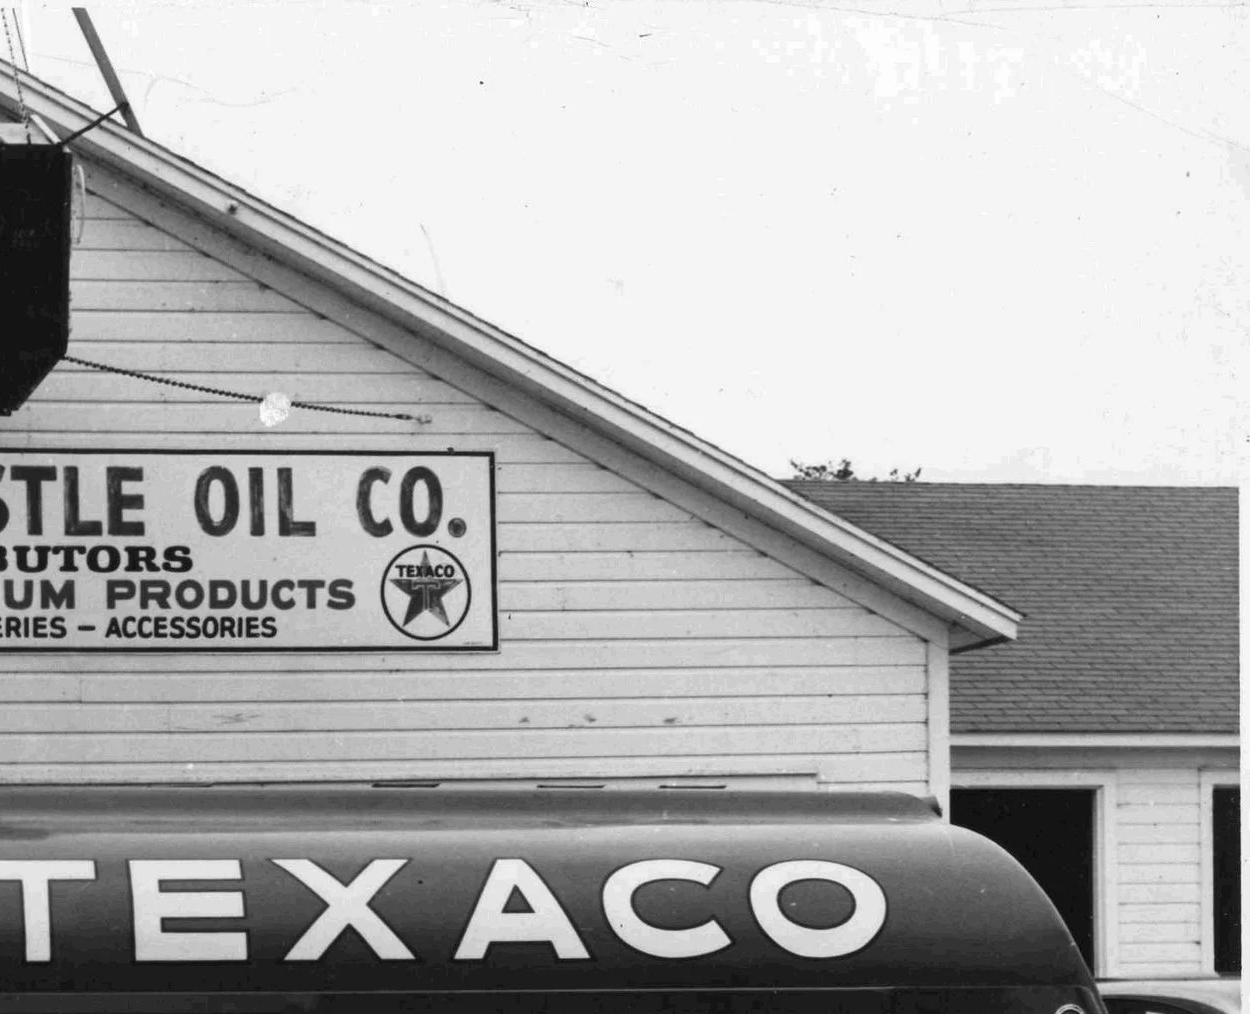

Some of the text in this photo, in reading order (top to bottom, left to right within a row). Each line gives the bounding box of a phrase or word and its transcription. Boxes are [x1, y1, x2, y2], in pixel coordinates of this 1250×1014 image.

[193, 465, 317, 538] OIL
[356, 465, 467, 538] CO.
[395, 564, 456, 578] TEXACO
[106, 578, 356, 611] PRODUCTS
[104, 615, 278, 640] ACCESSORIES
